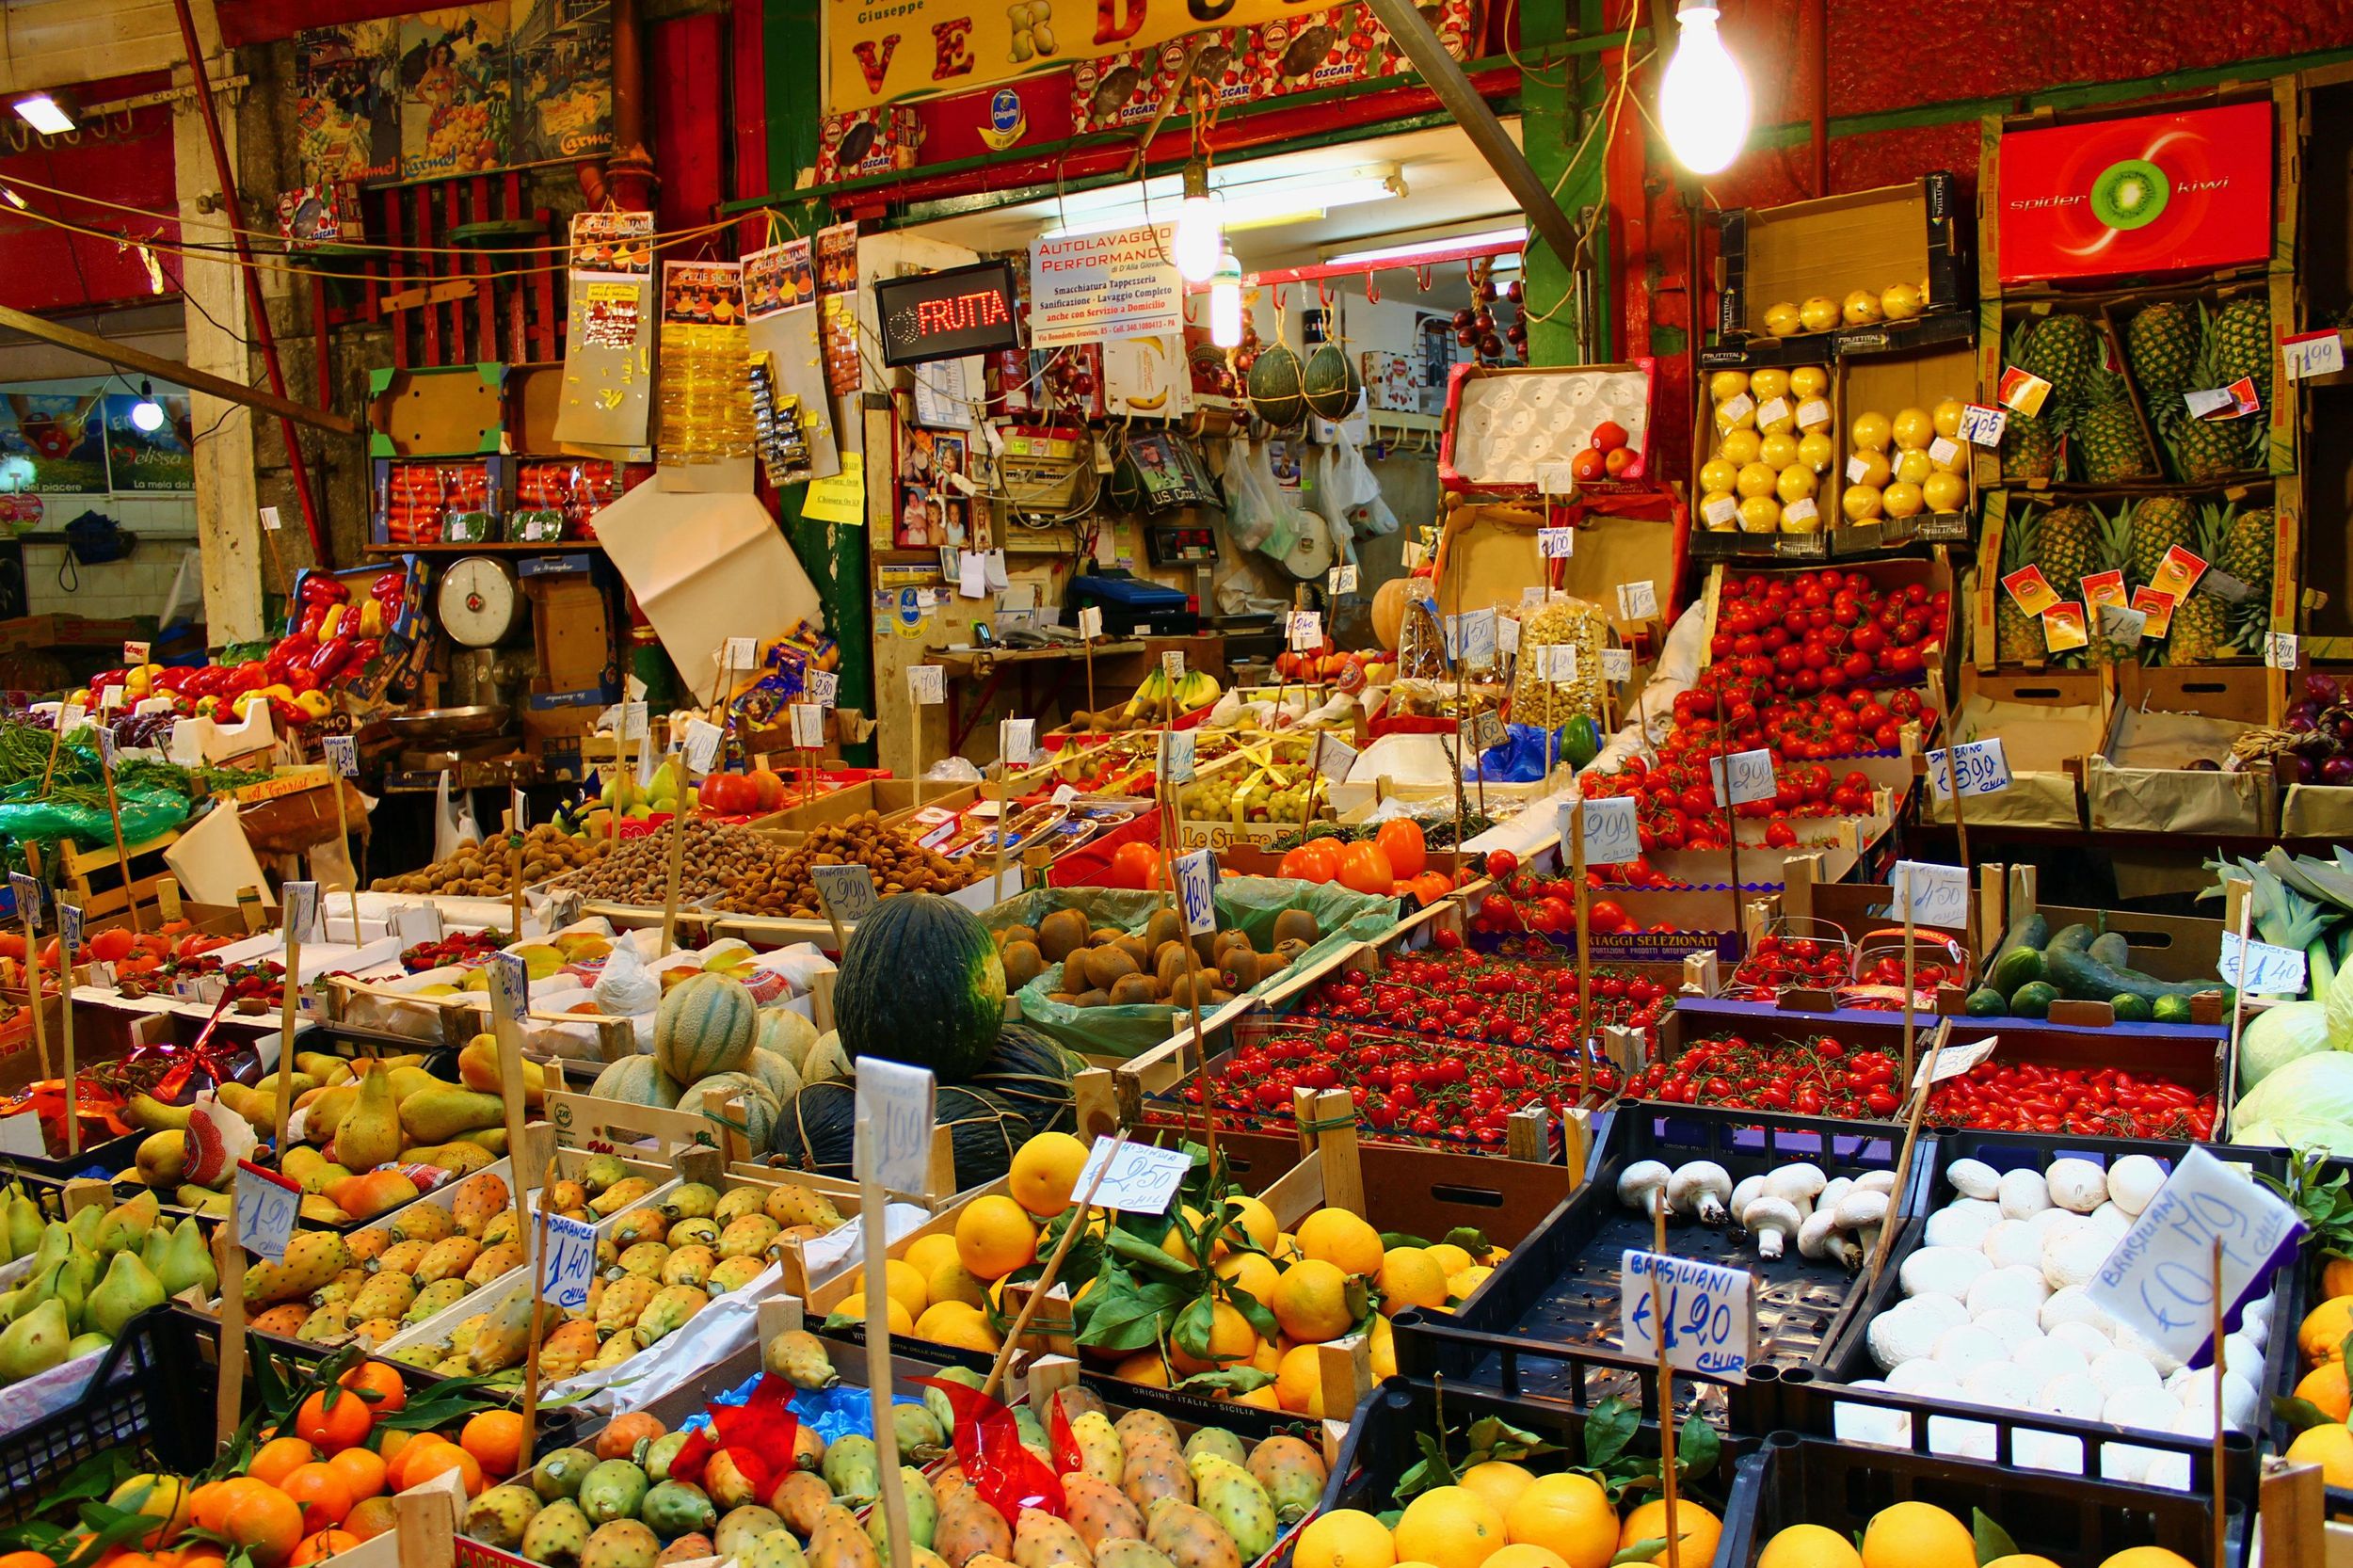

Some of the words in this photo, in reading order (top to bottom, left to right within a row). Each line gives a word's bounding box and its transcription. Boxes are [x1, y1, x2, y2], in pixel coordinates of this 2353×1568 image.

[857, 1, 924, 24] Giuseppe
[1315, 64, 1354, 79] OSCAR
[1122, 104, 1158, 118] OSCAR
[560, 131, 613, 154] Carme
[403, 145, 456, 178] Carmel
[862, 156, 890, 170] OSCAR
[2009, 192, 2089, 213] spider
[2176, 175, 2230, 195] kiwi
[1038, 227, 1172, 257] AUTOLAVAGGIO
[750, 258, 775, 272] SPEZIE
[1041, 246, 1170, 273] PERFORMANCE
[678, 271, 708, 281] SPEZIE
[1054, 281, 1107, 296] Smacchiatura
[1109, 275, 1157, 289] Tappezzeria
[1039, 297, 1091, 311] Sanificazione
[1096, 291, 1132, 303] Lavaggio
[1134, 286, 1173, 299] Completo
[918, 289, 1009, 336] FRUTTA
[1047, 312, 1069, 322] anche
[1086, 305, 1119, 317] Servizio
[1128, 299, 1166, 312] Domicilio
[1037, 333, 1047, 342] Via
[1048, 330, 1076, 341] Benedetto
[1838, 334, 1880, 344] FRUTTITAL
[110, 445, 182, 467] Melissa
[42, 482, 83, 492] piacere
[134, 480, 145, 489] La
[148, 480, 172, 489] mela
[174, 479, 190, 488] del
[1184, 827, 1207, 848] Le
[1211, 827, 1272, 848] Sure
[1589, 936, 1633, 947] RTAGGI
[1636, 936, 1719, 947] SELEZIONATI
[1589, 947, 1625, 955] SPORTAZIONE
[1629, 947, 1658, 955] PRODOTTI
[1131, 1387, 1174, 1401] ORIGINE:
[1177, 1397, 1209, 1410] ITALIA
[1219, 1404, 1256, 1416] SICILIA
